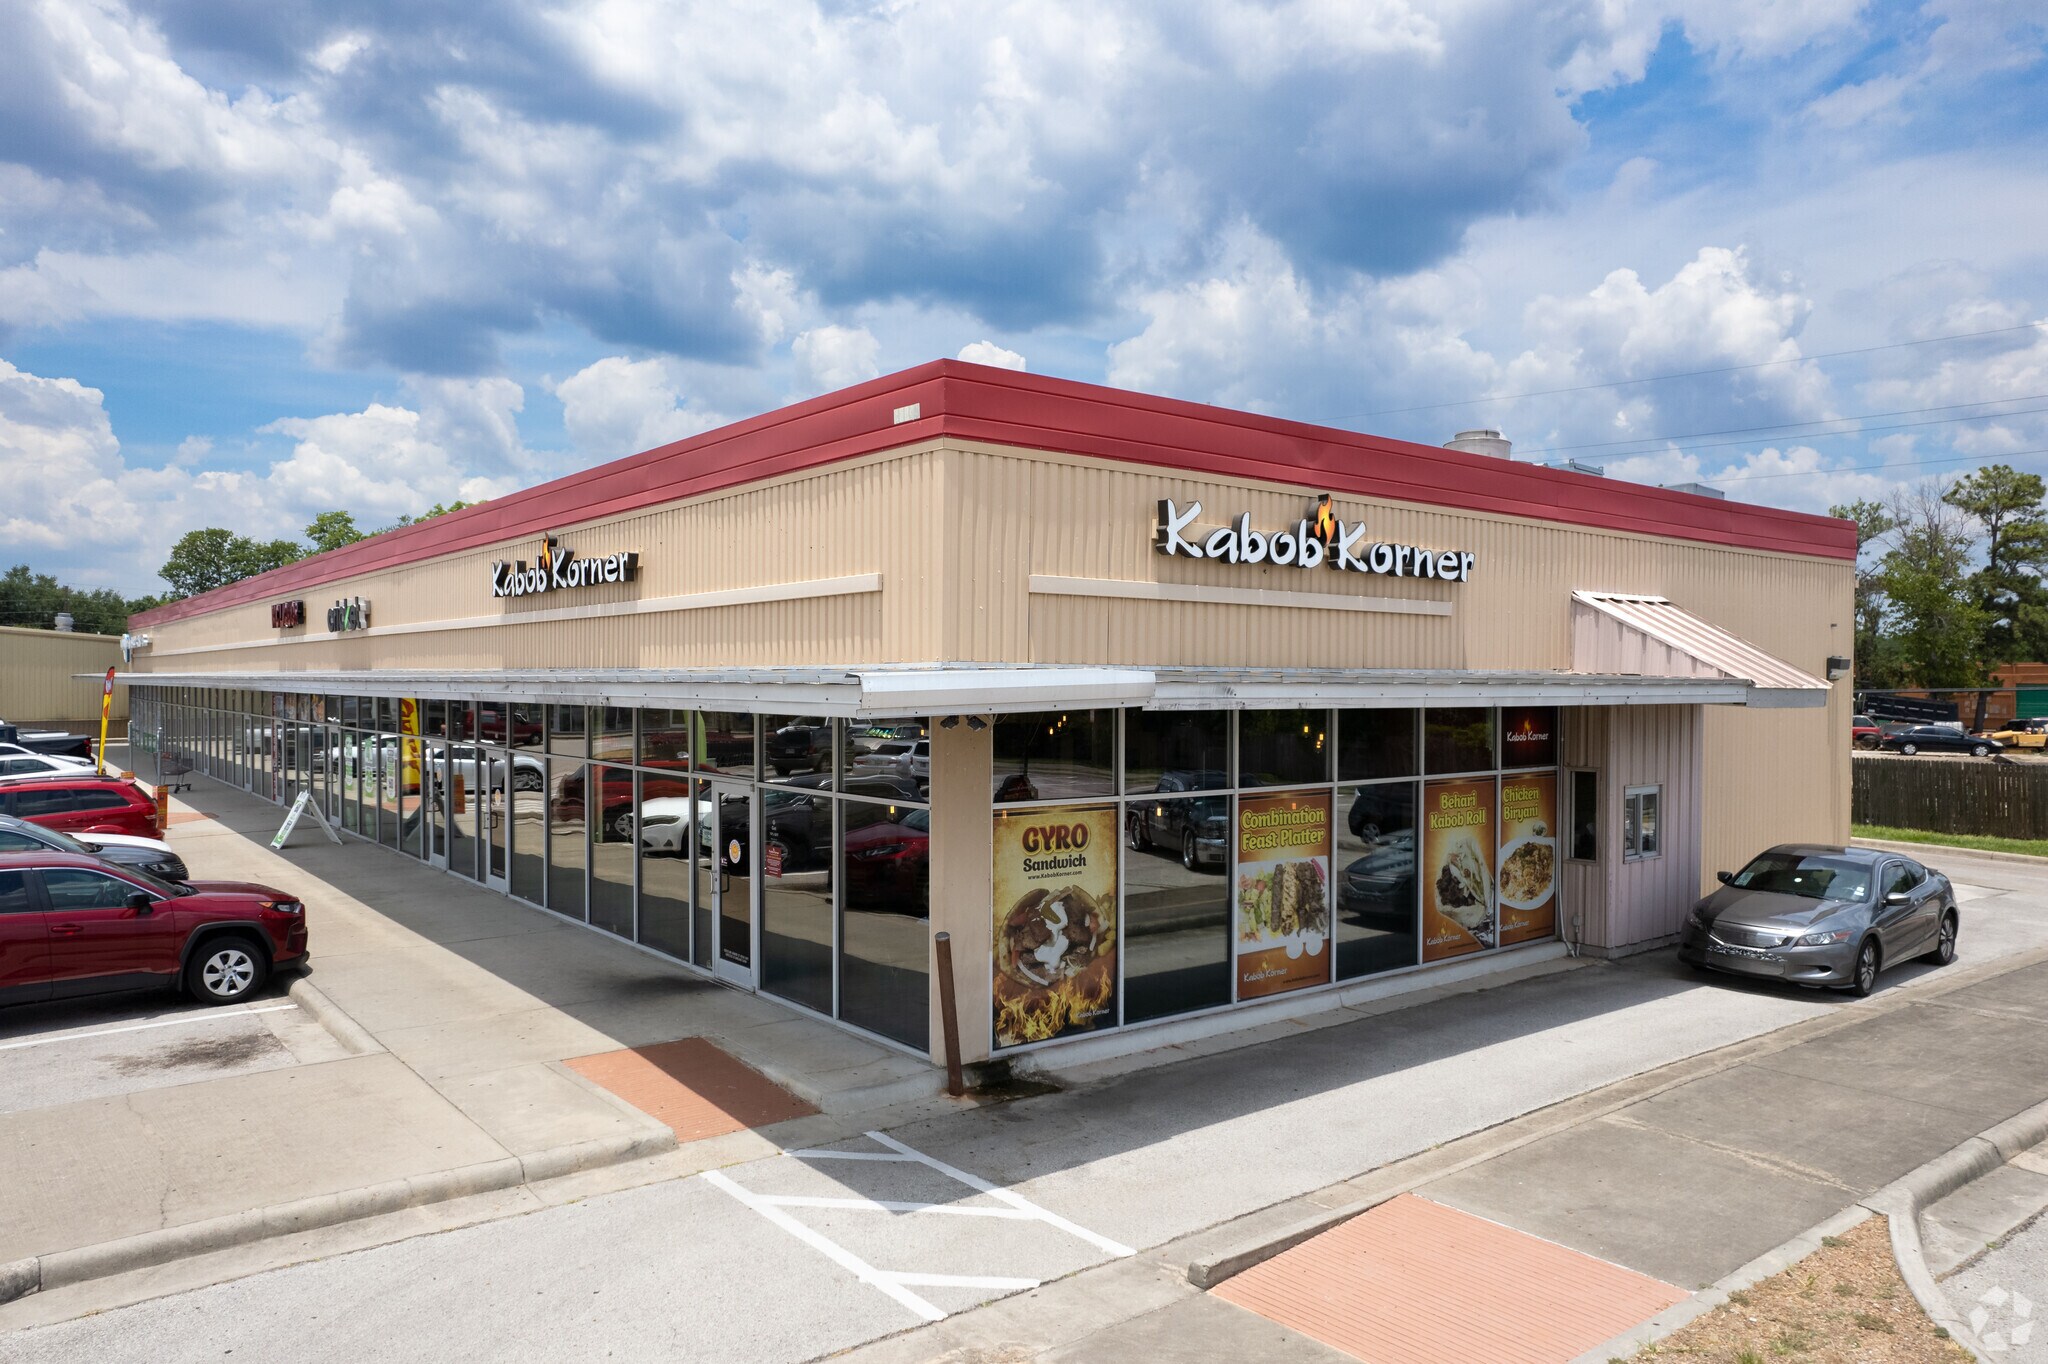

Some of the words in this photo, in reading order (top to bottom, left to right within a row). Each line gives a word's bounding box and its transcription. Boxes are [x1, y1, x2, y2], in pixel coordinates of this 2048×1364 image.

[1160, 498, 1324, 568] Kabob
[1332, 519, 1476, 582] Korner
[491, 556, 547, 597] Kabob
[551, 547, 630, 588] Korner
[1506, 731, 1527, 742] Kabob
[1527, 730, 1549, 740] Korner
[1441, 792, 1477, 809] Behari
[1503, 787, 1540, 803] Chicken
[1242, 807, 1325, 829] Combination
[1430, 811, 1464, 830] Kabob
[1466, 808, 1487, 825] Roll
[1503, 804, 1540, 822] Biryani
[1021, 822, 1090, 854] GYRO
[1242, 831, 1278, 852] Feast
[1280, 829, 1325, 847] Platter
[1023, 854, 1087, 873] Sandwich
[1028, 870, 1083, 880] www.KabobKorner.com
[1243, 972, 1265, 983] Kabob
[1265, 967, 1288, 978] Korner
